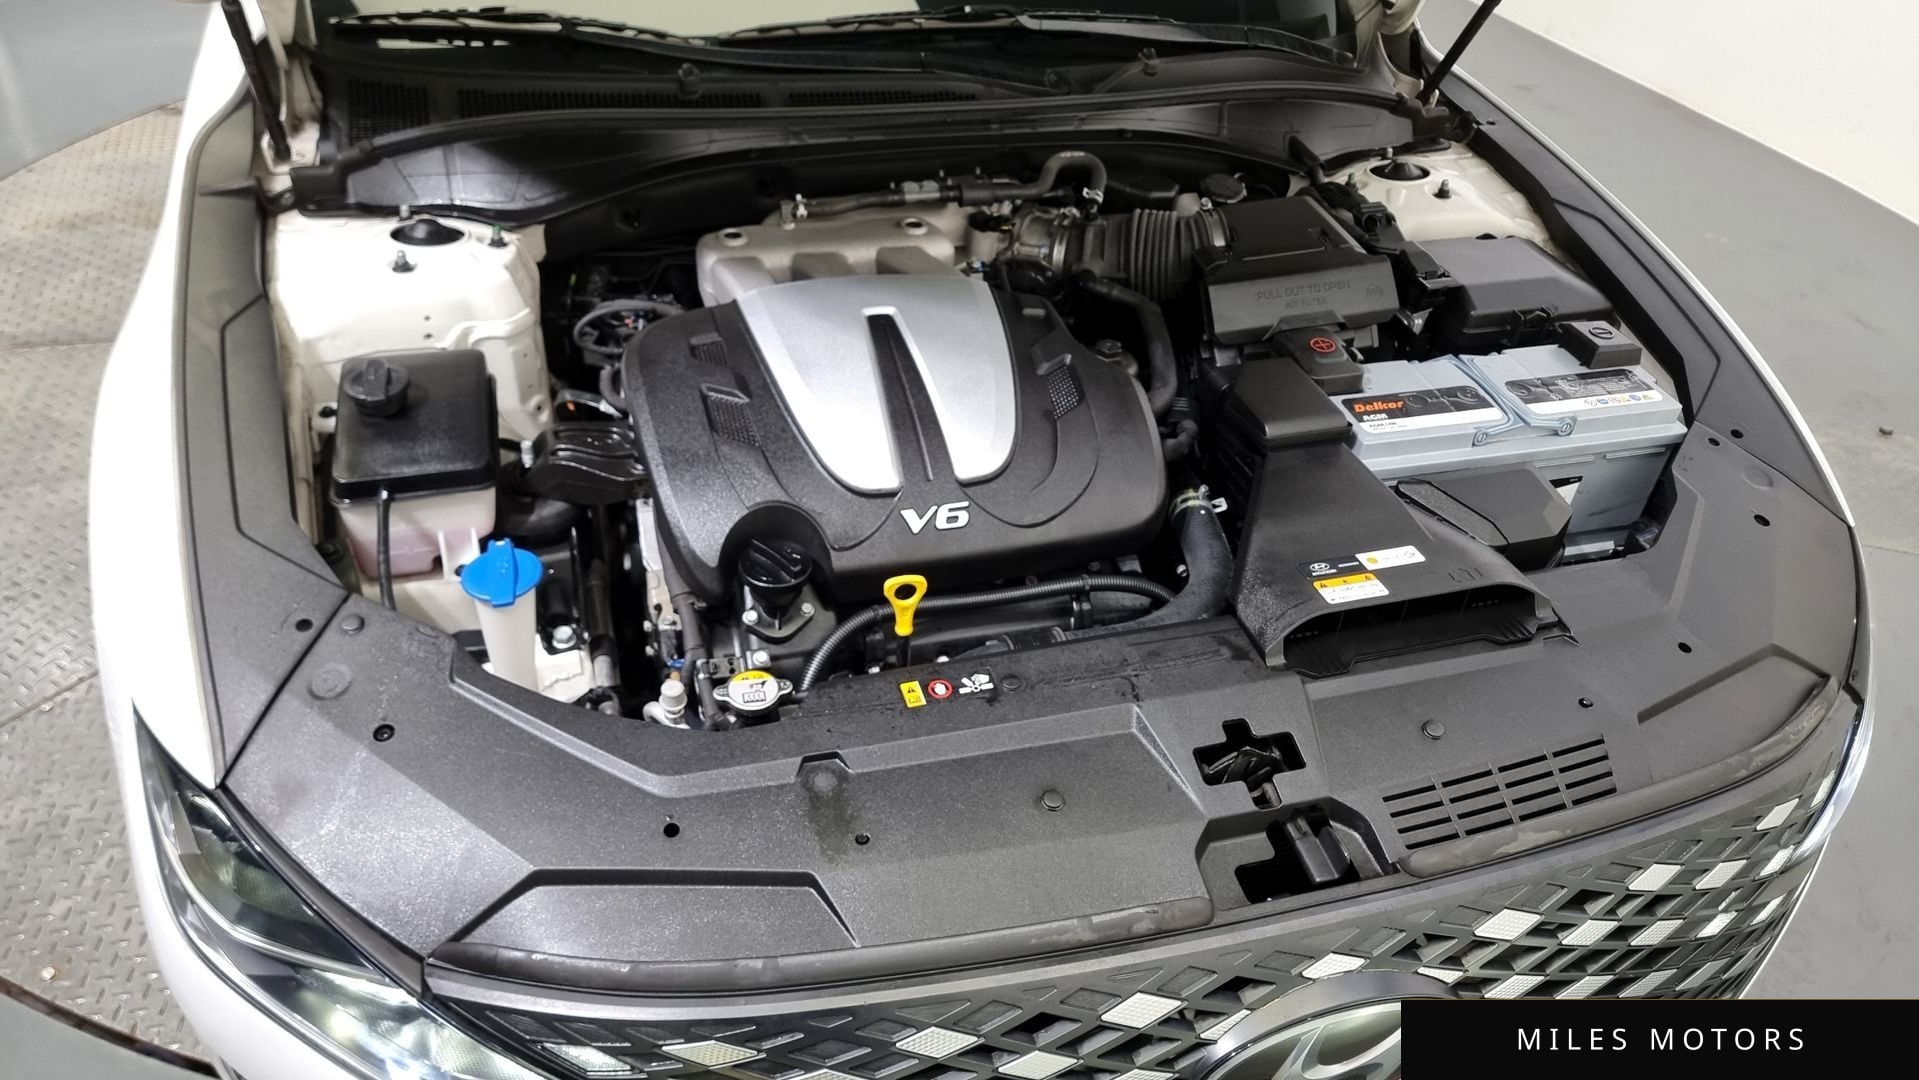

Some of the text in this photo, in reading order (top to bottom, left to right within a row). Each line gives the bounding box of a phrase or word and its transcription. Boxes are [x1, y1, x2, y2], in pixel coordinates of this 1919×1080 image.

[1256, 279, 1352, 300] PULL OUT TO OPEN
[1353, 400, 1405, 413] Delkor
[1362, 413, 1389, 422] AGM
[900, 501, 970, 534] V6
